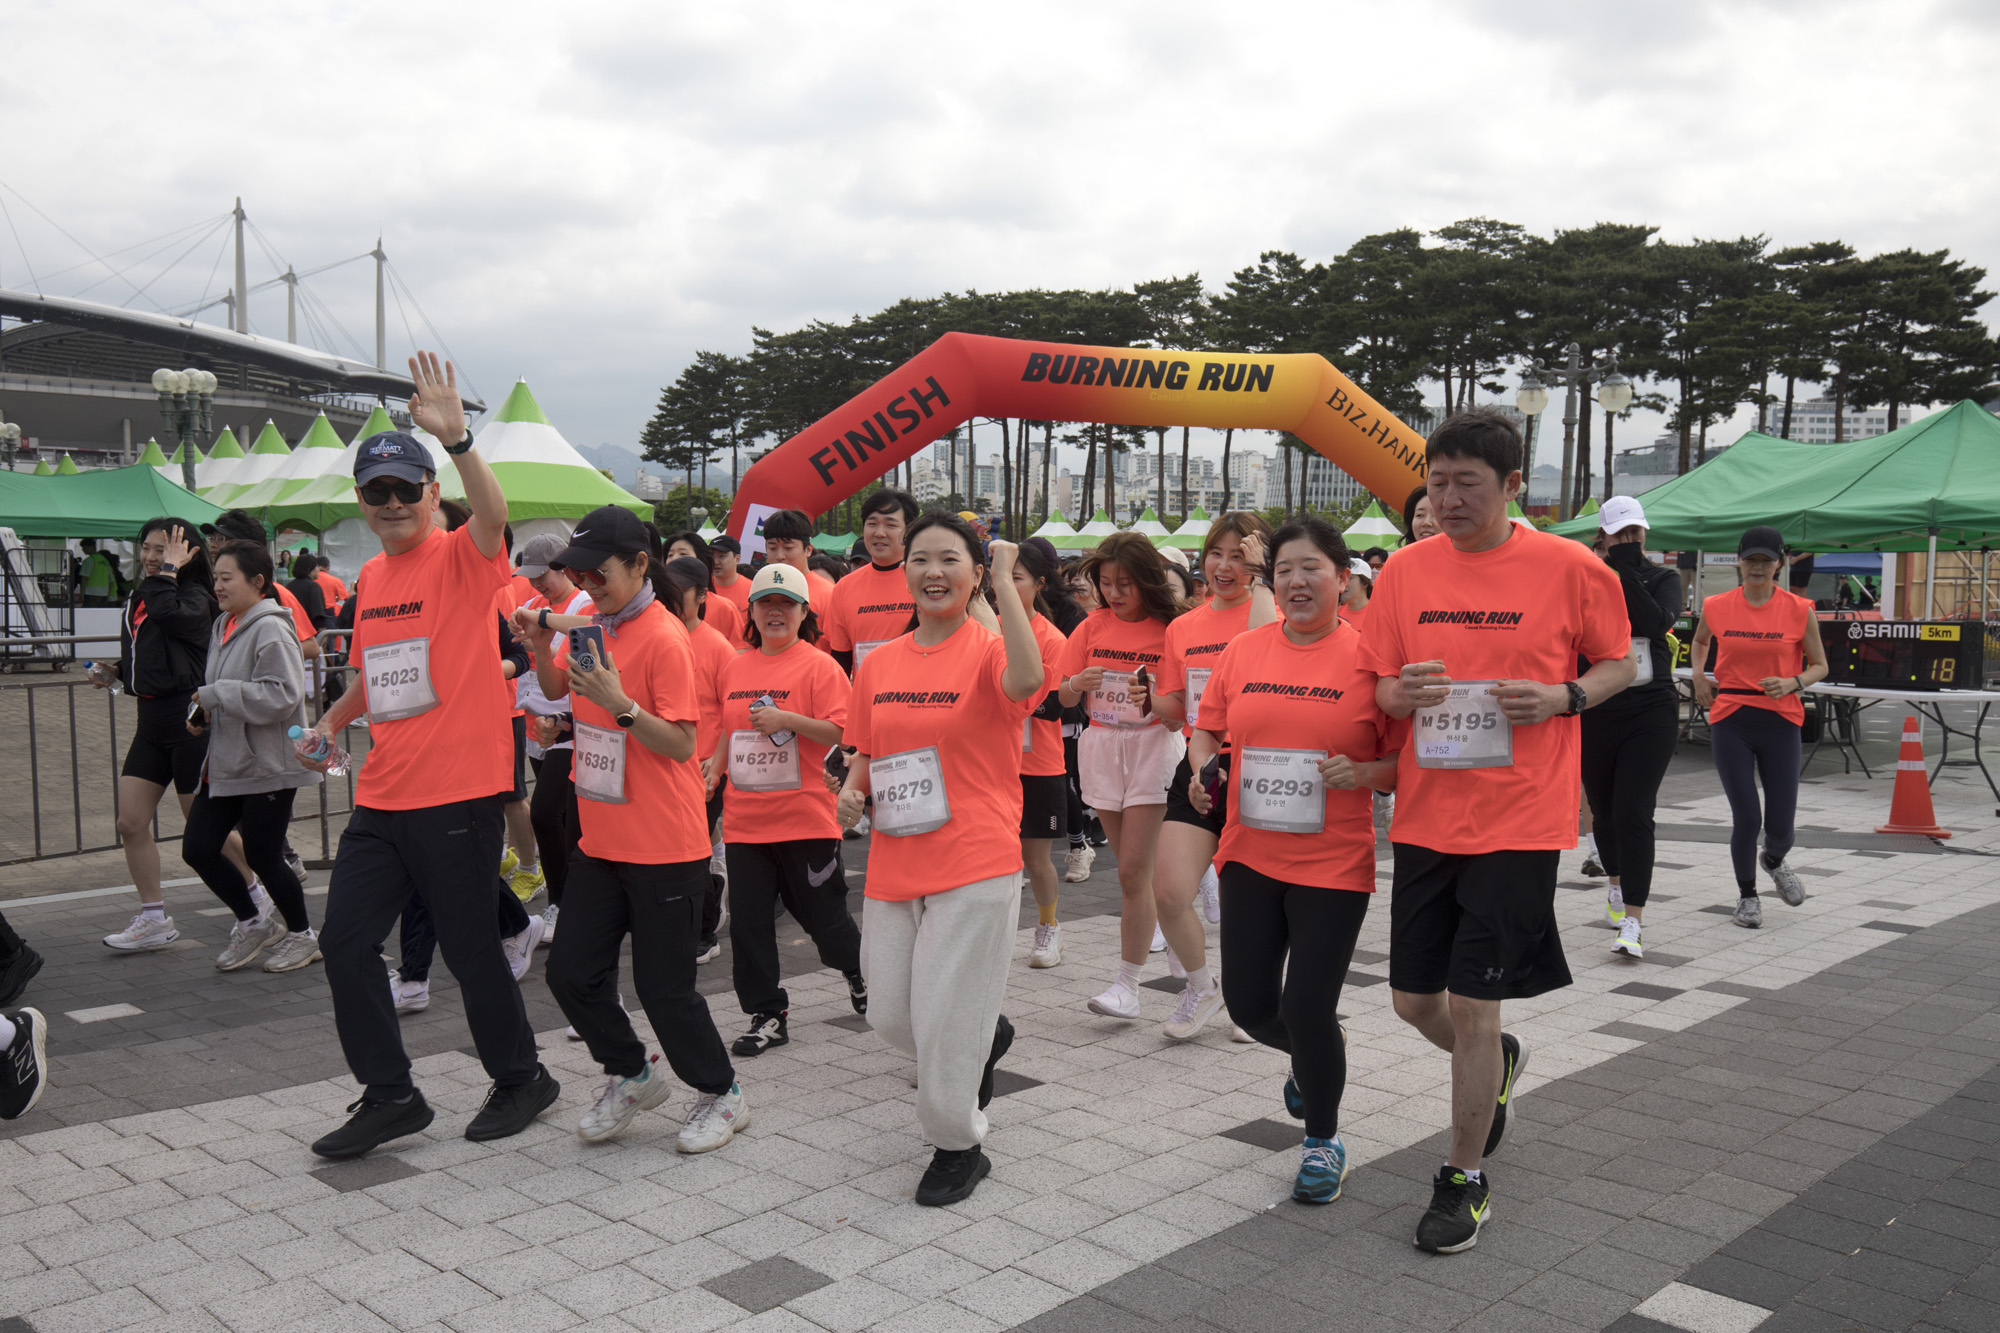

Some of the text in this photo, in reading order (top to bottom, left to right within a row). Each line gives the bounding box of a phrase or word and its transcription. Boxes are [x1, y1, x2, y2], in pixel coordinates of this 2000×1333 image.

[1021, 352, 1275, 392] BURNING RUN
[808, 375, 951, 487] FINISH
[361, 604, 398, 621] BURNING
[857, 603, 897, 614] BURNING
[1418, 611, 1524, 625] BURNING RUN
[1723, 630, 1764, 639] BURNING
[1928, 628, 1952, 638] 5km
[1092, 648, 1138, 662] BURNING
[1136, 652, 1162, 664] RUN
[1185, 642, 1228, 657] BURNING
[372, 667, 419, 688] M 5023
[1931, 658, 1956, 682] 18
[727, 690, 790, 700] BURNING RUN
[873, 692, 960, 705] BURNING RUN
[1095, 692, 1103, 700] W
[1242, 682, 1344, 700] BURNING RUN
[1093, 711, 1114, 721] D-354
[1422, 712, 1497, 731] M 5195
[1242, 753, 1270, 762] BURNING
[1426, 746, 1450, 754] A-752
[578, 750, 616, 772] W 6381
[736, 751, 788, 765] W 6278
[877, 779, 933, 802] W 6279
[1243, 778, 1313, 797] W 6293
